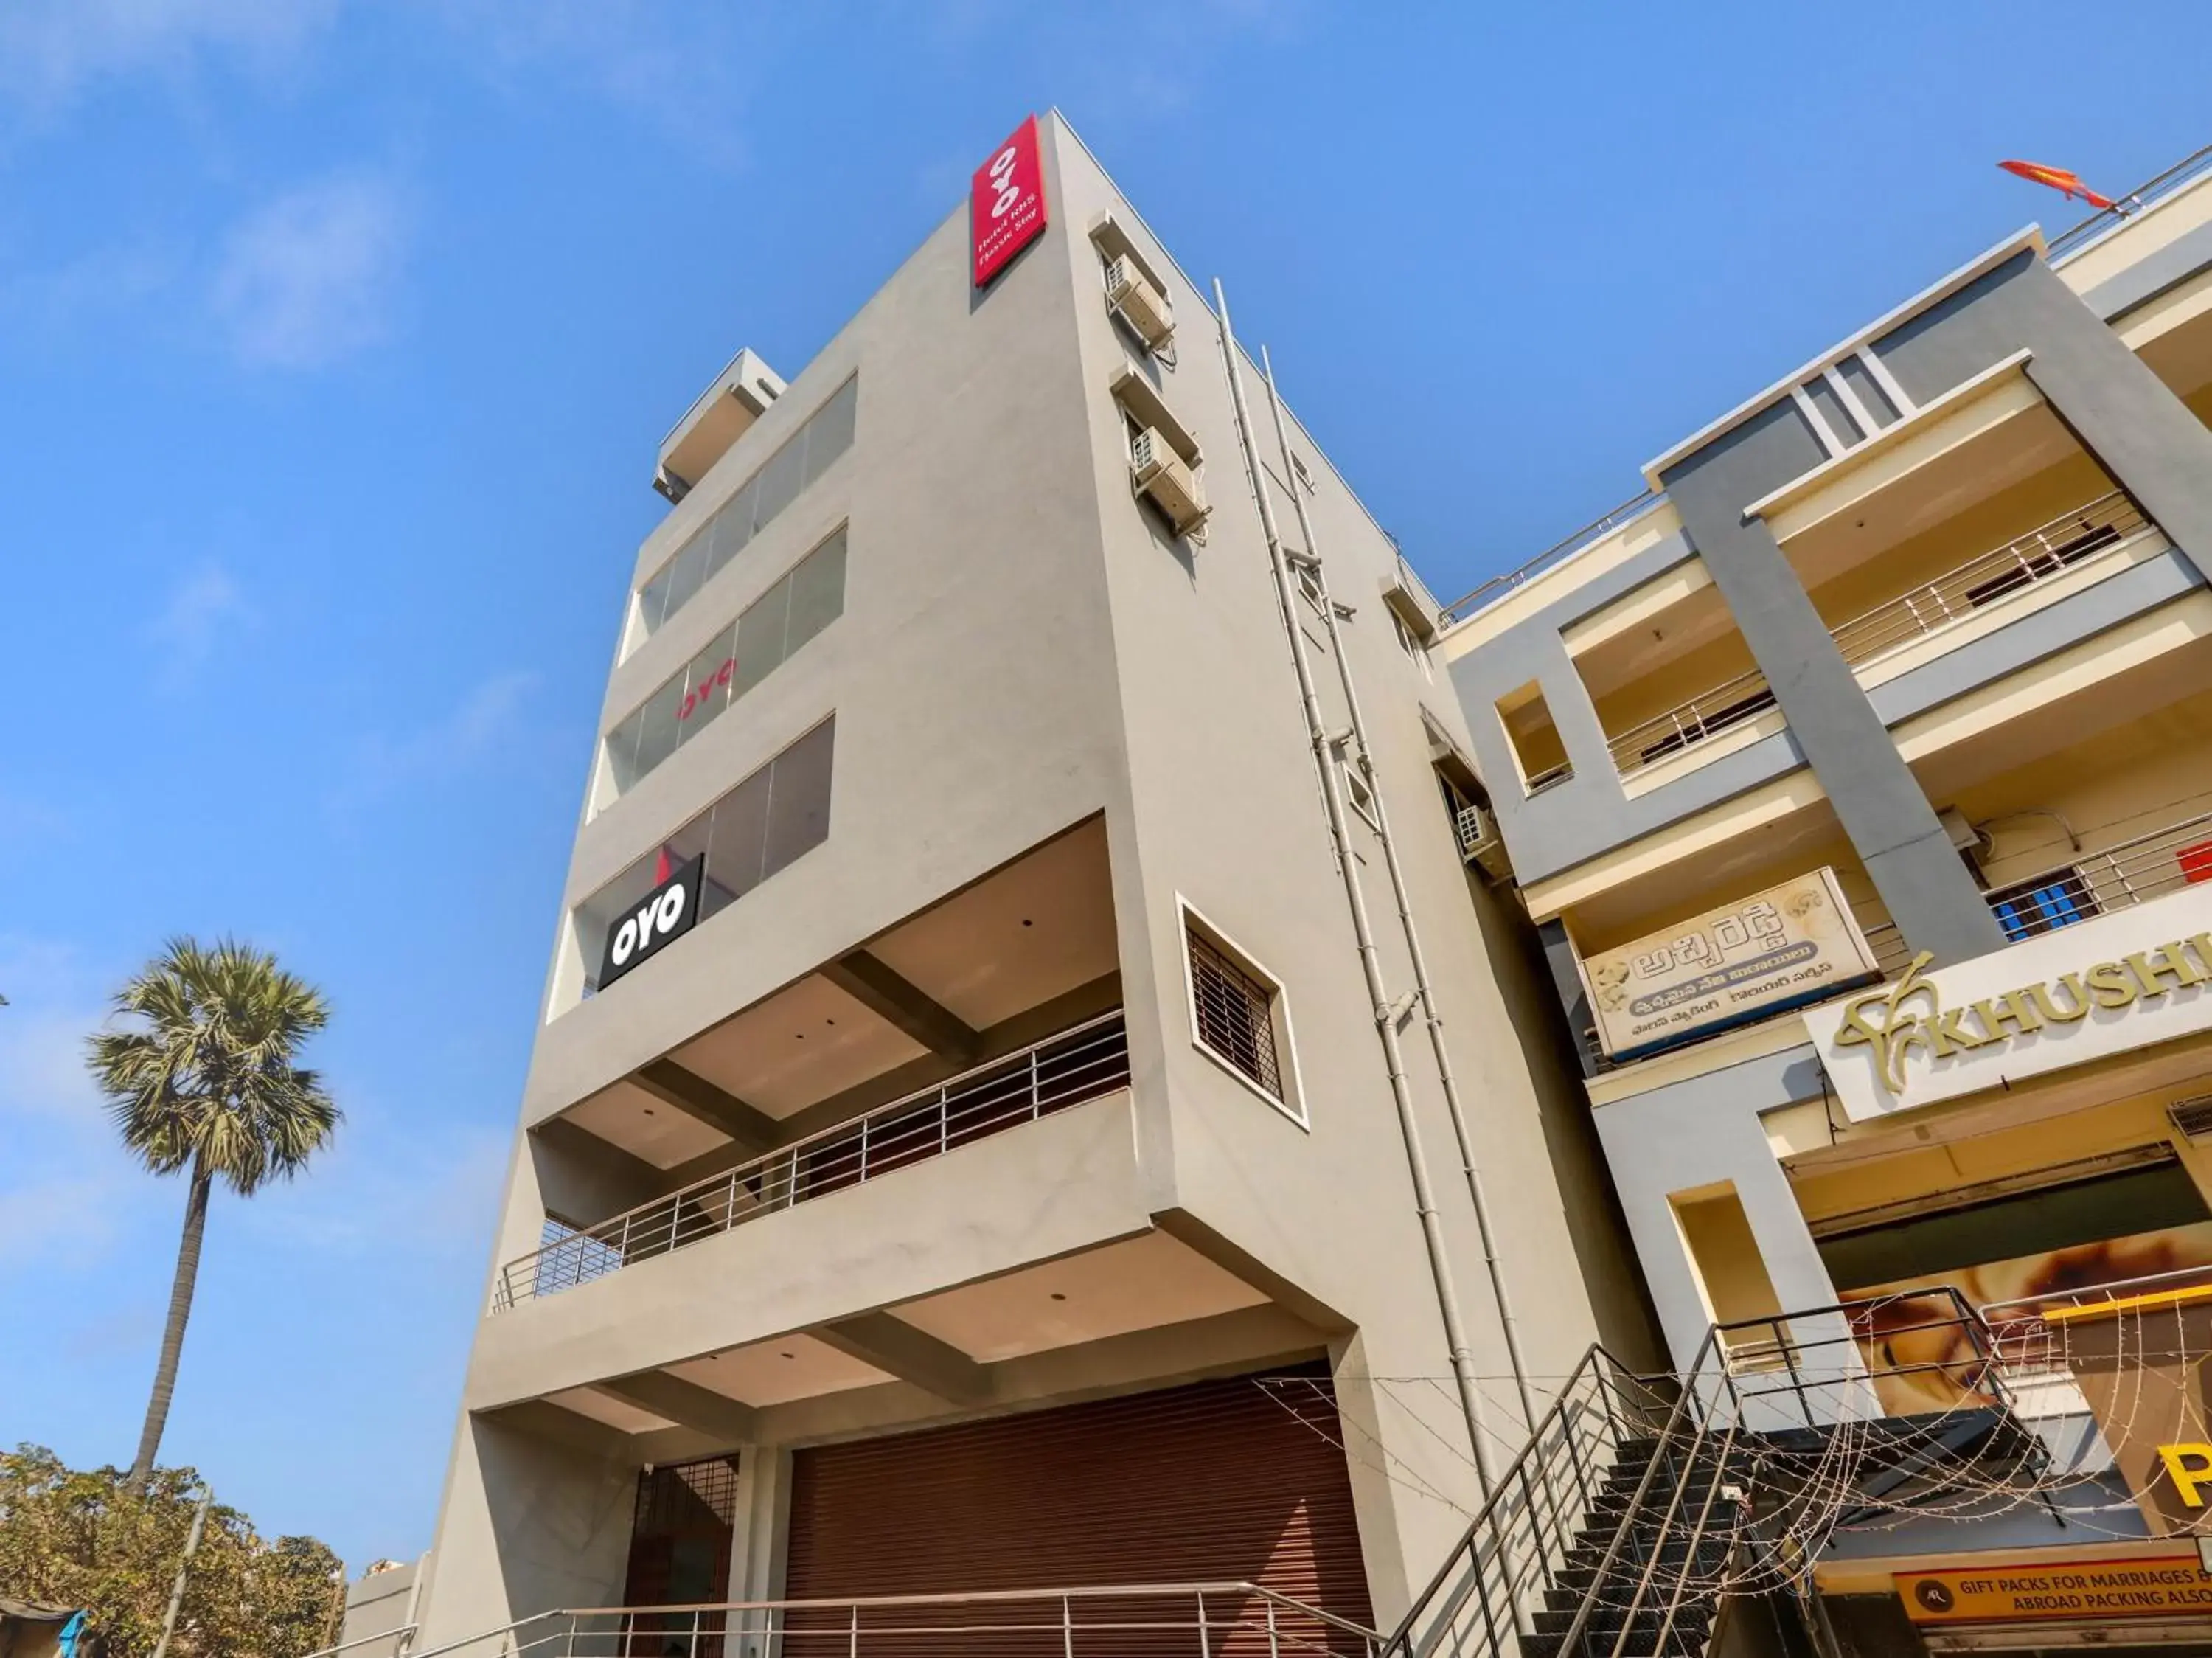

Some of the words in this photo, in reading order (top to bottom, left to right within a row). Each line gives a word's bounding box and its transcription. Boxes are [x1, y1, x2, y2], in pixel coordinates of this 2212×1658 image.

[990, 147, 1019, 218] OYO
[1015, 207, 1037, 231] Stay
[674, 658, 737, 720] OYO
[612, 884, 686, 966] OYO
[1960, 1580, 1994, 1594] GIFT
[1998, 1577, 2051, 1592] PACKS
[2052, 1575, 2088, 1589] FOR
[2090, 1569, 2194, 1588] MARRIAGES
[2013, 1595, 2082, 1611] ABROAD
[2085, 1591, 2164, 1608] PACKING
[2168, 1589, 2212, 1604] ALSO
